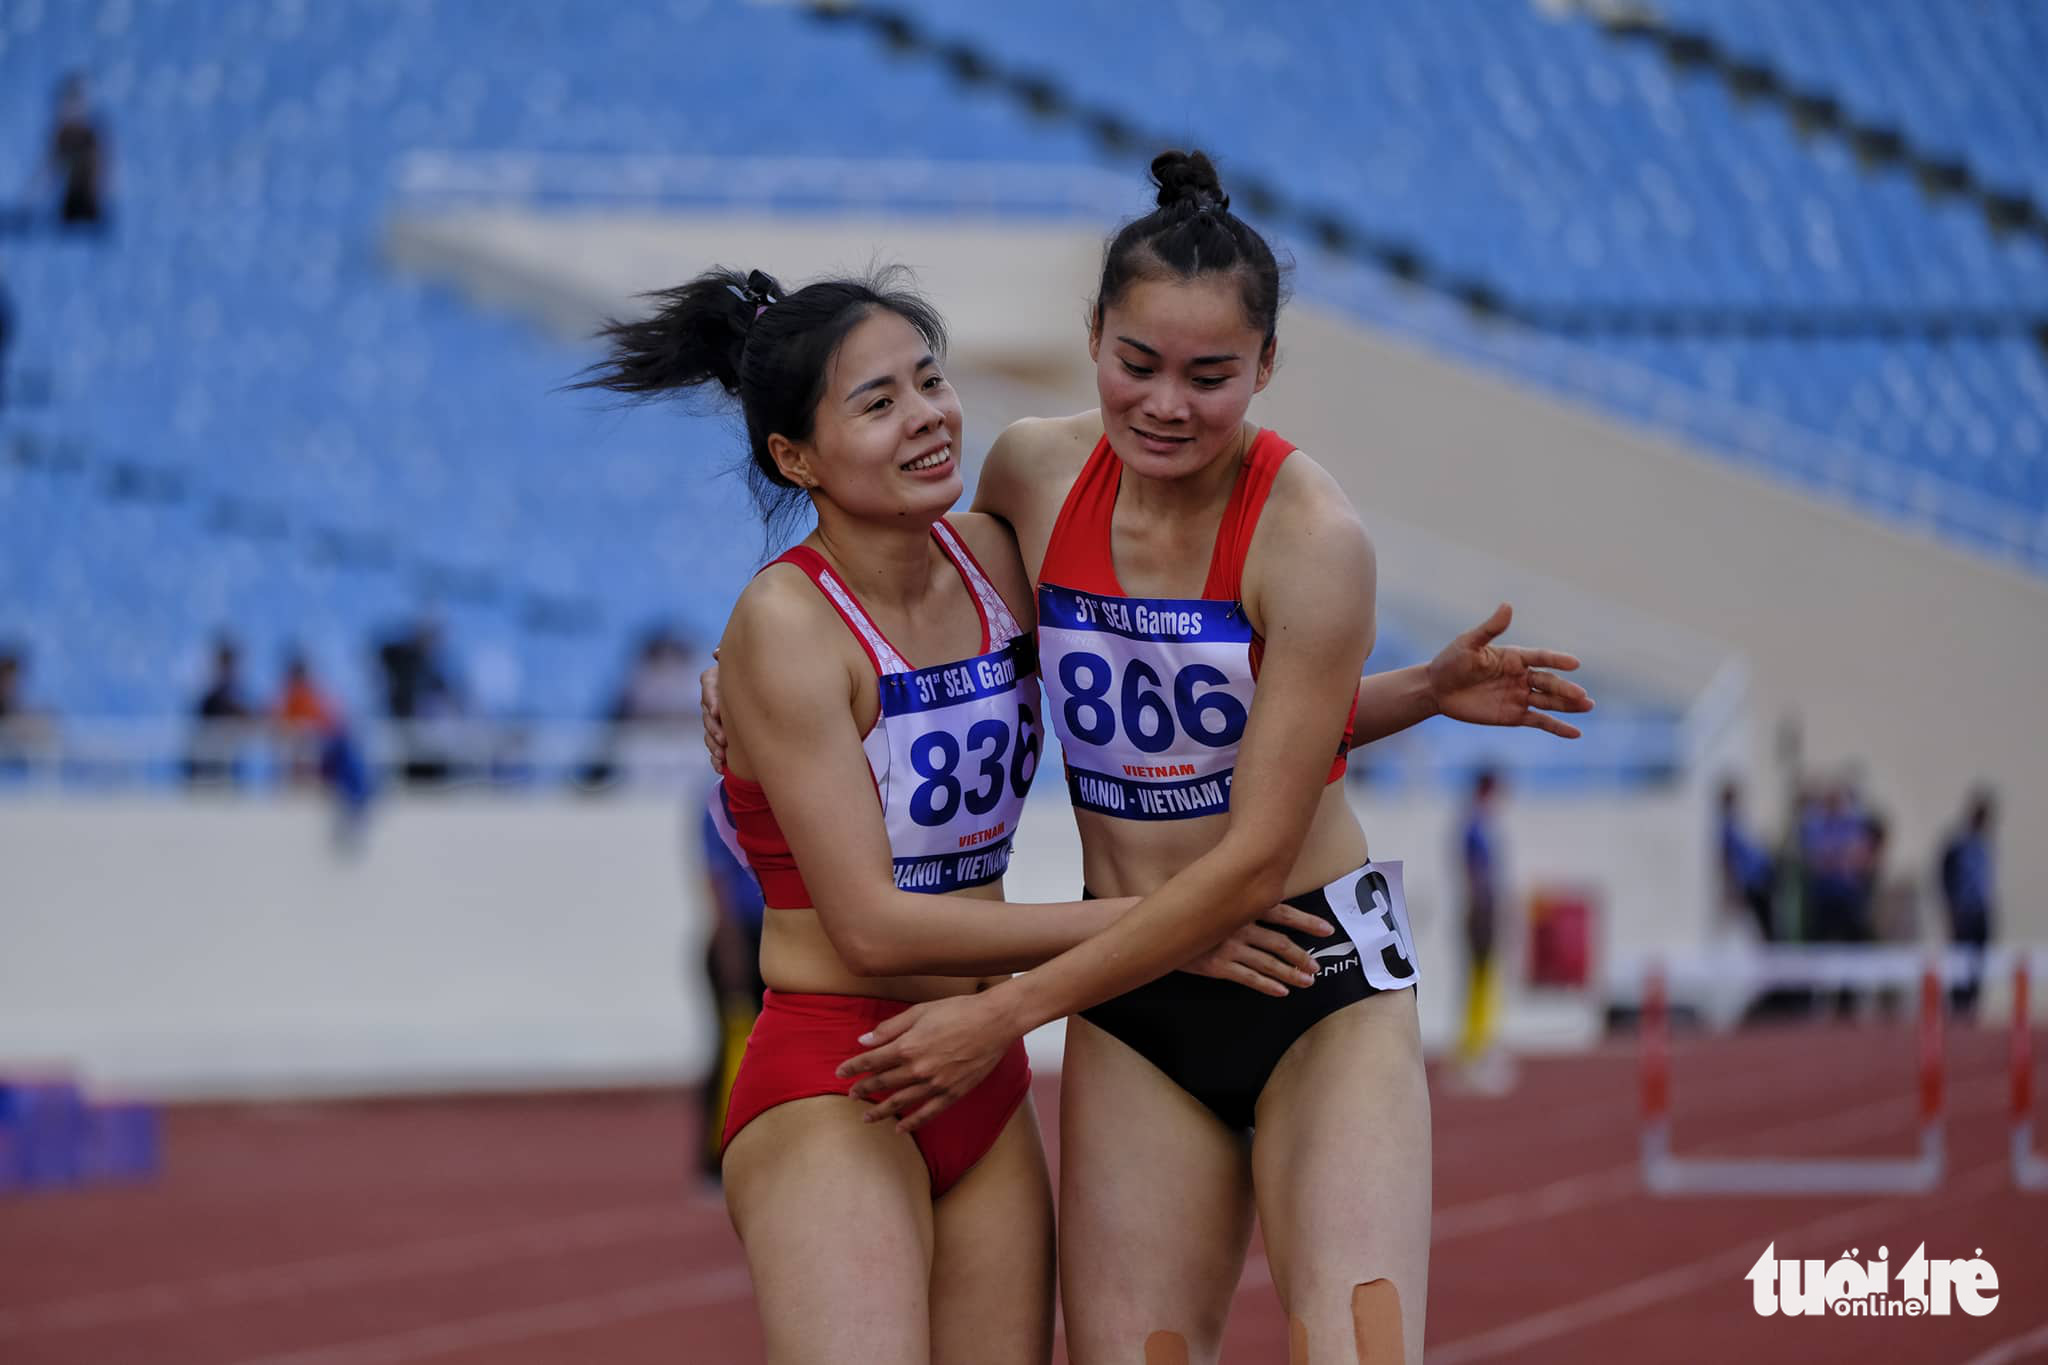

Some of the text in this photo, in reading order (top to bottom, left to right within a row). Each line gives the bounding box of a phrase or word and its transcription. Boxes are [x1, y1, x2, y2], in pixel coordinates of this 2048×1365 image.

[1102, 602, 1132, 632] SEA
[1136, 605, 1202, 635] Games
[943, 666, 976, 699] SEA
[1058, 651, 1248, 753] 866
[909, 703, 1039, 827] 836
[1122, 764, 1196, 778] VIETNAM
[1080, 776, 1125, 810] HANOI
[1137, 780, 1224, 814] VIETNAM
[959, 822, 1005, 848] VIETNAM
[893, 859, 944, 888] HANOI
[1354, 870, 1415, 979] 3
